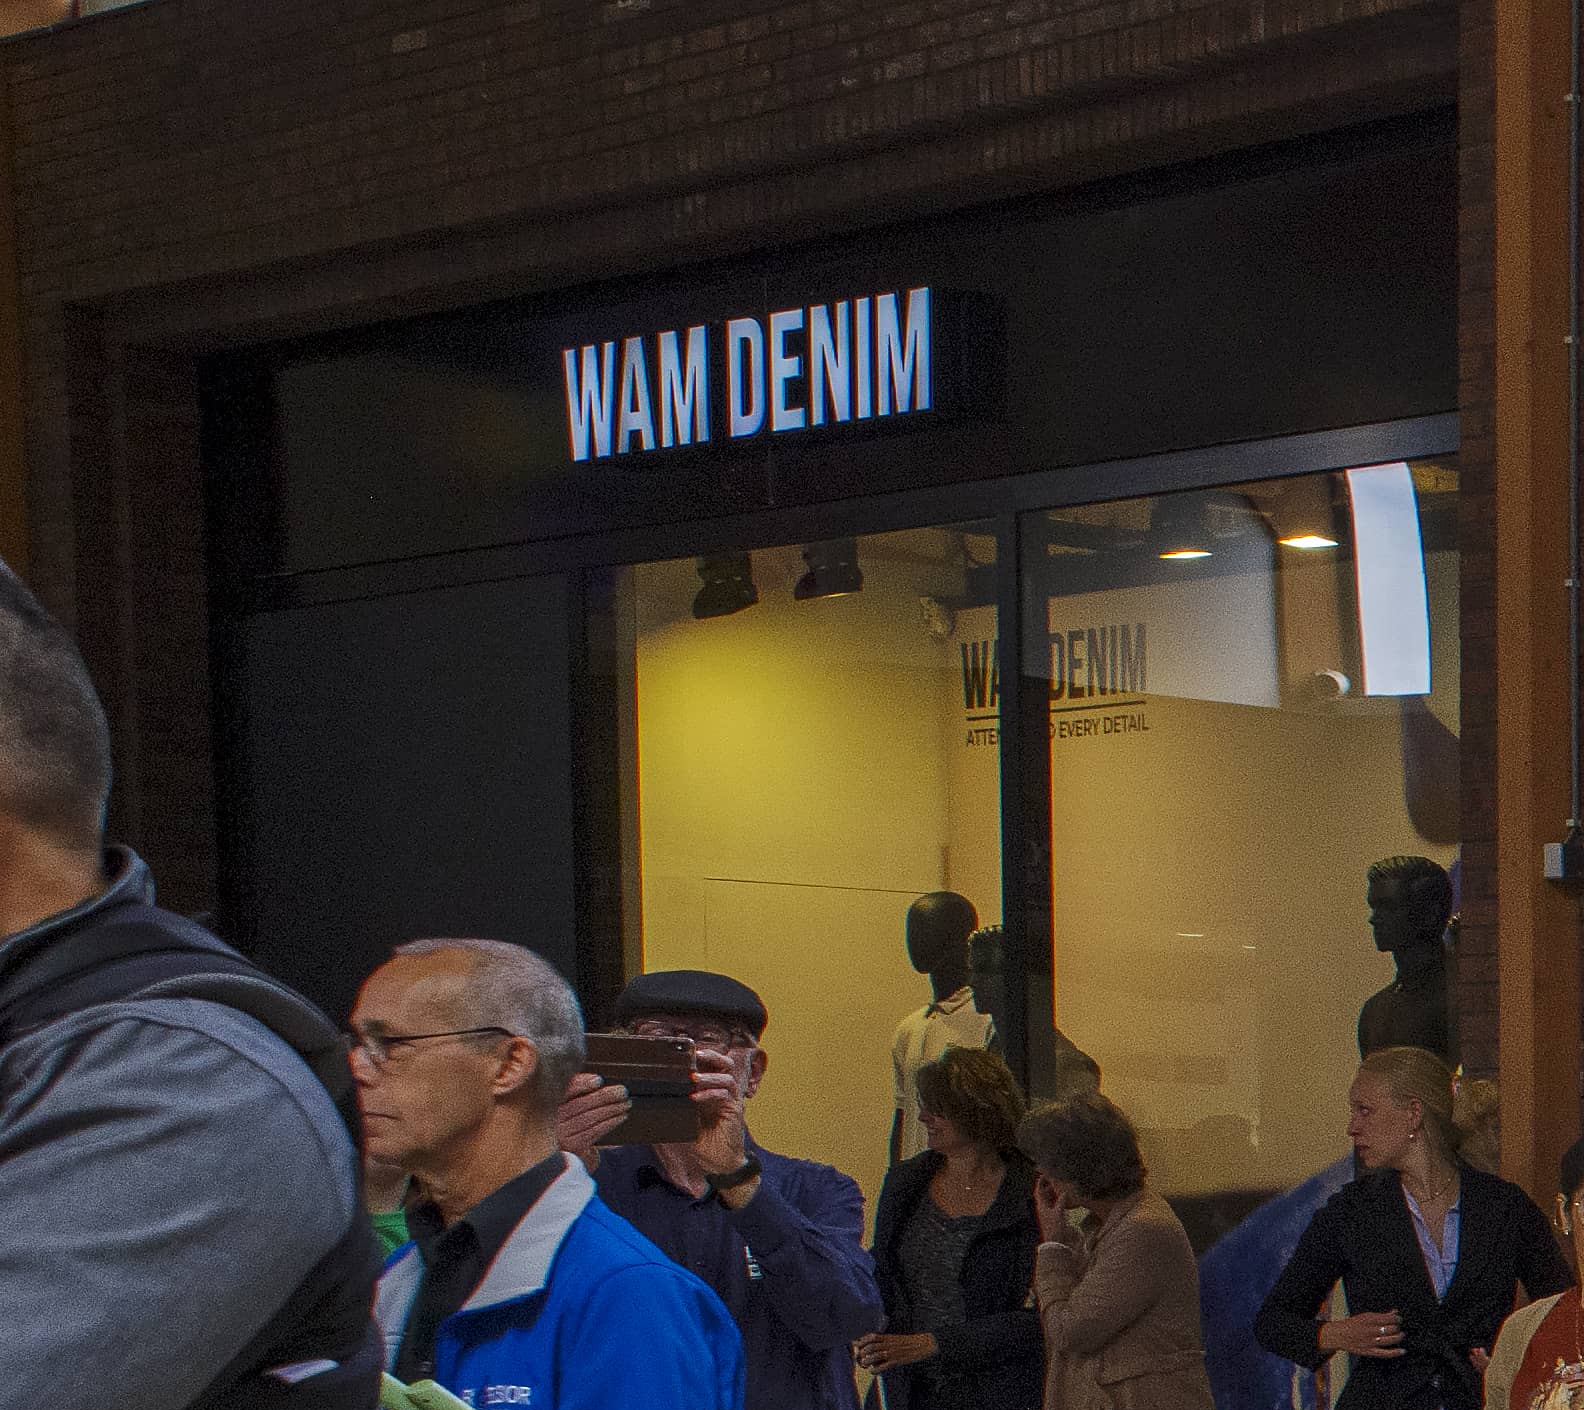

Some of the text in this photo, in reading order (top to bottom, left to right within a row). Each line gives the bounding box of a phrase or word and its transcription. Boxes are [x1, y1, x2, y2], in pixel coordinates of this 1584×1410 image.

[562, 286, 933, 462] WAM DENIM
[1058, 717, 1100, 740] EVERY
[1102, 712, 1151, 735] DETAIL
